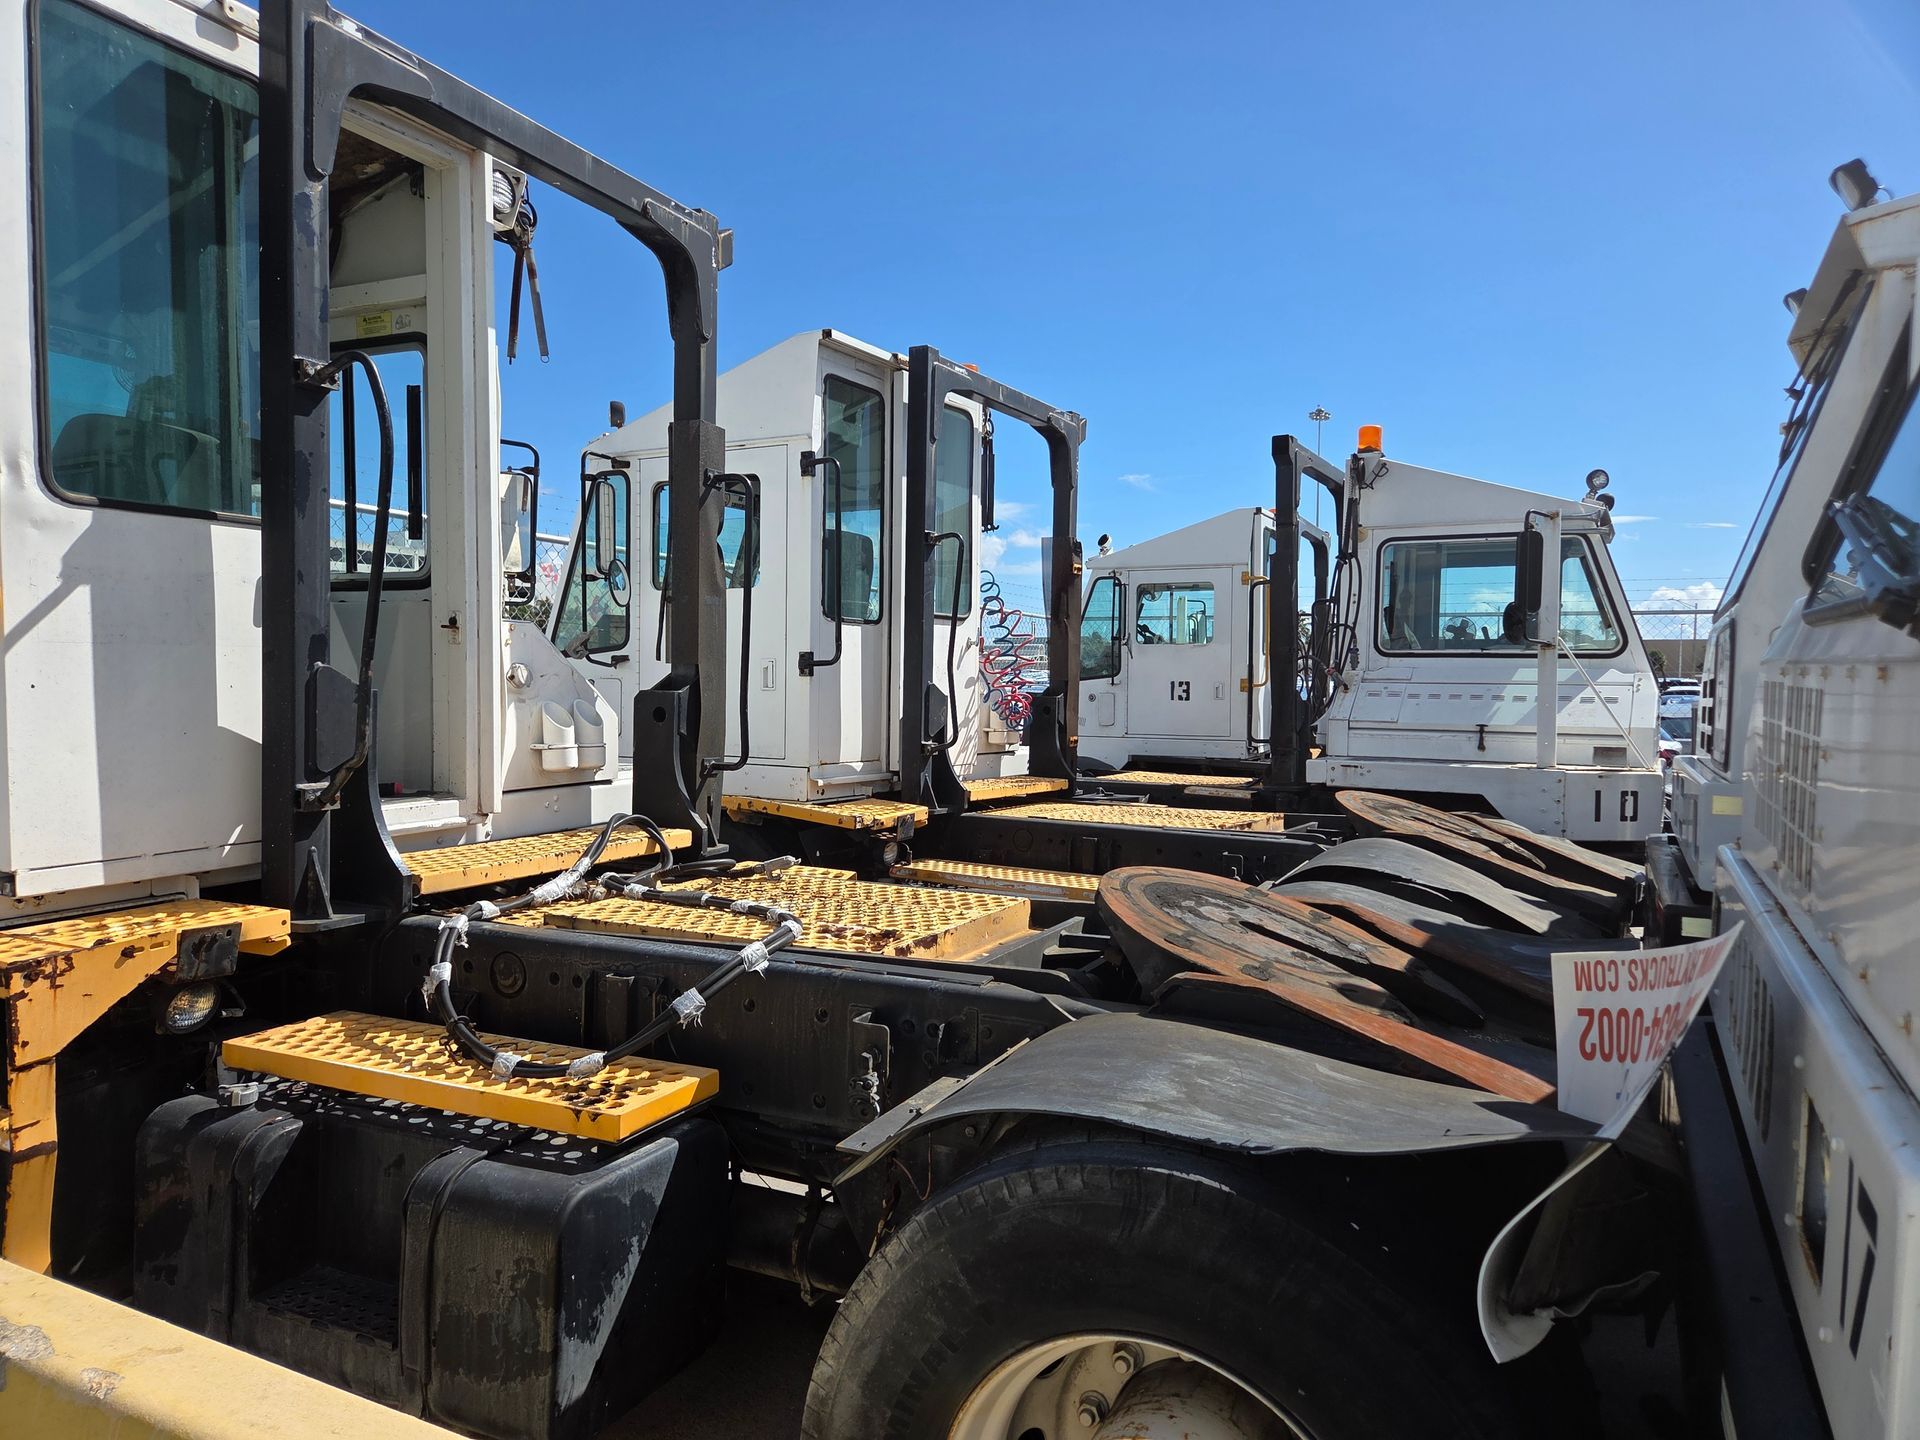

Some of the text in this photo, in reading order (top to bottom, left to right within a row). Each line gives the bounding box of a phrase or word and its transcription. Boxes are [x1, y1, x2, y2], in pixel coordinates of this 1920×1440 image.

[1170, 680, 1190, 701] 13
[1594, 790, 1639, 822] 10
[1840, 1156, 1877, 1361] 17
